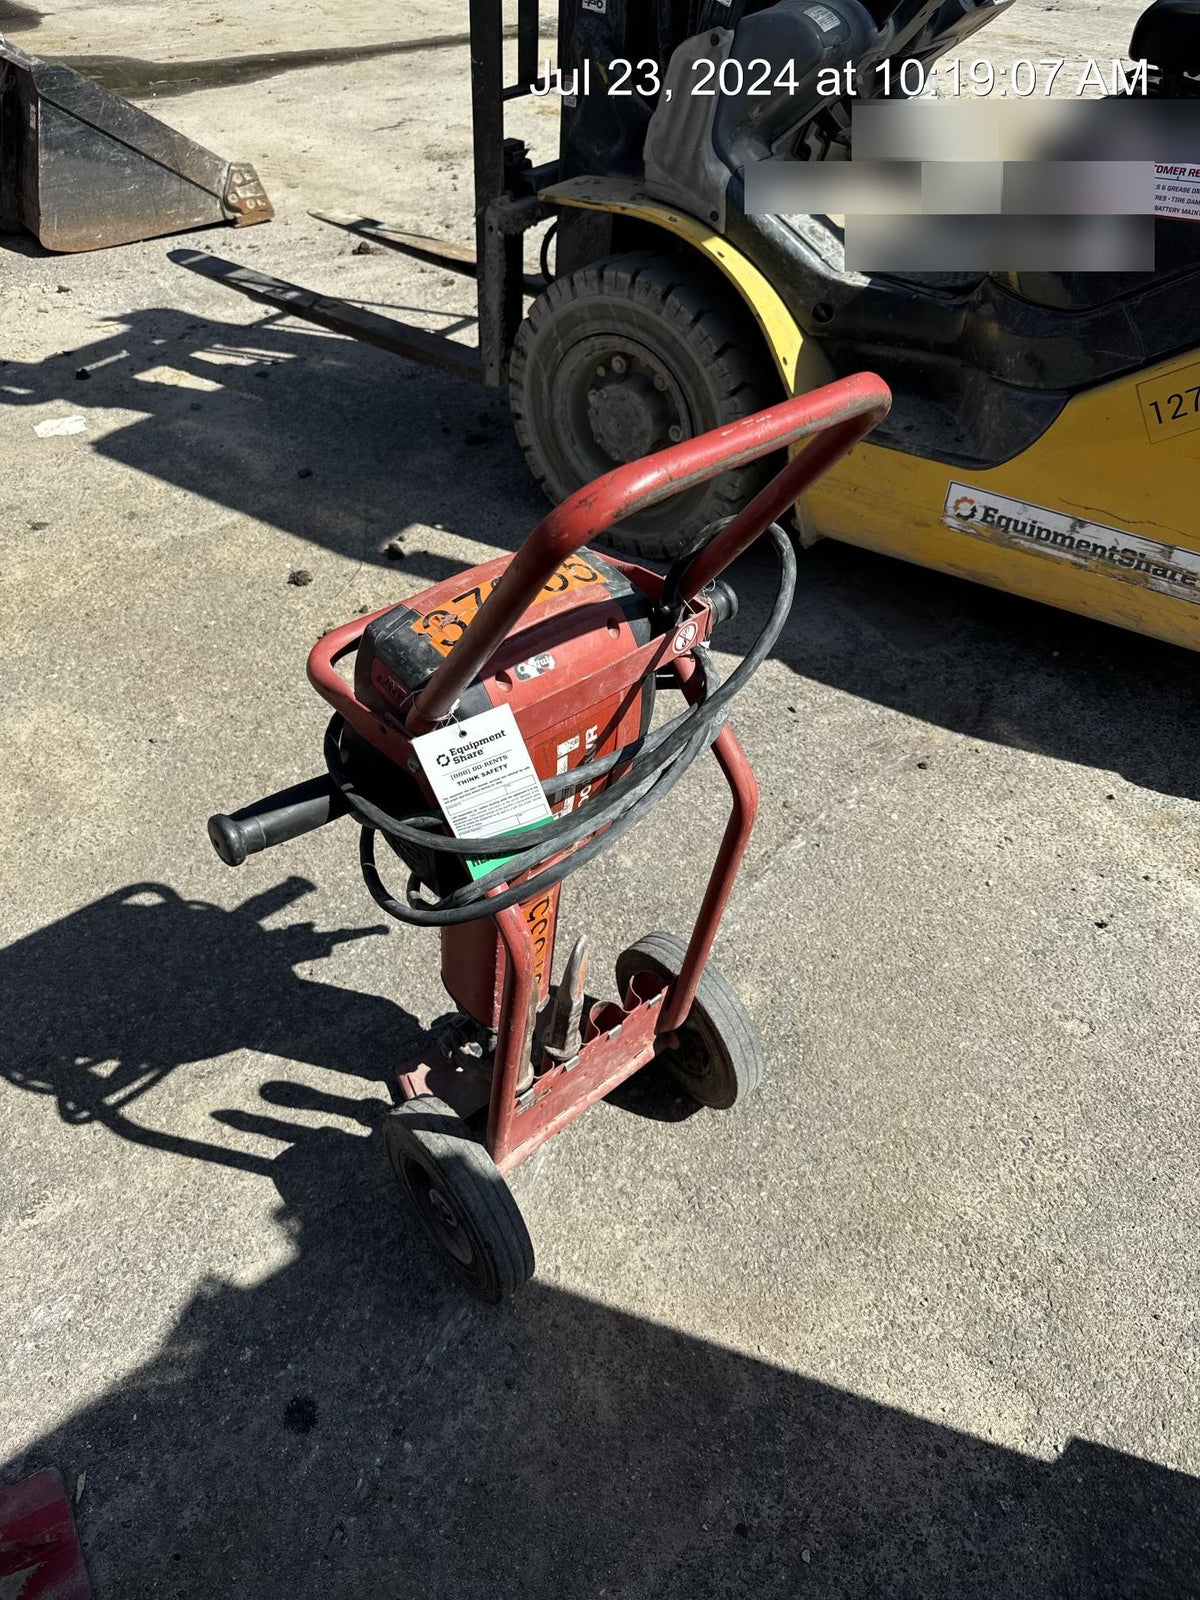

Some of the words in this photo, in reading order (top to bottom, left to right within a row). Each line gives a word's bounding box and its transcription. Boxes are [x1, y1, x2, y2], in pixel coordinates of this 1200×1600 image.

[1149, 386, 1200, 424] 127
[449, 729, 507, 757] Equipment
[452, 748, 484, 765] Share
[456, 774, 480, 787] THINK
[481, 763, 508, 778] SAFETY
